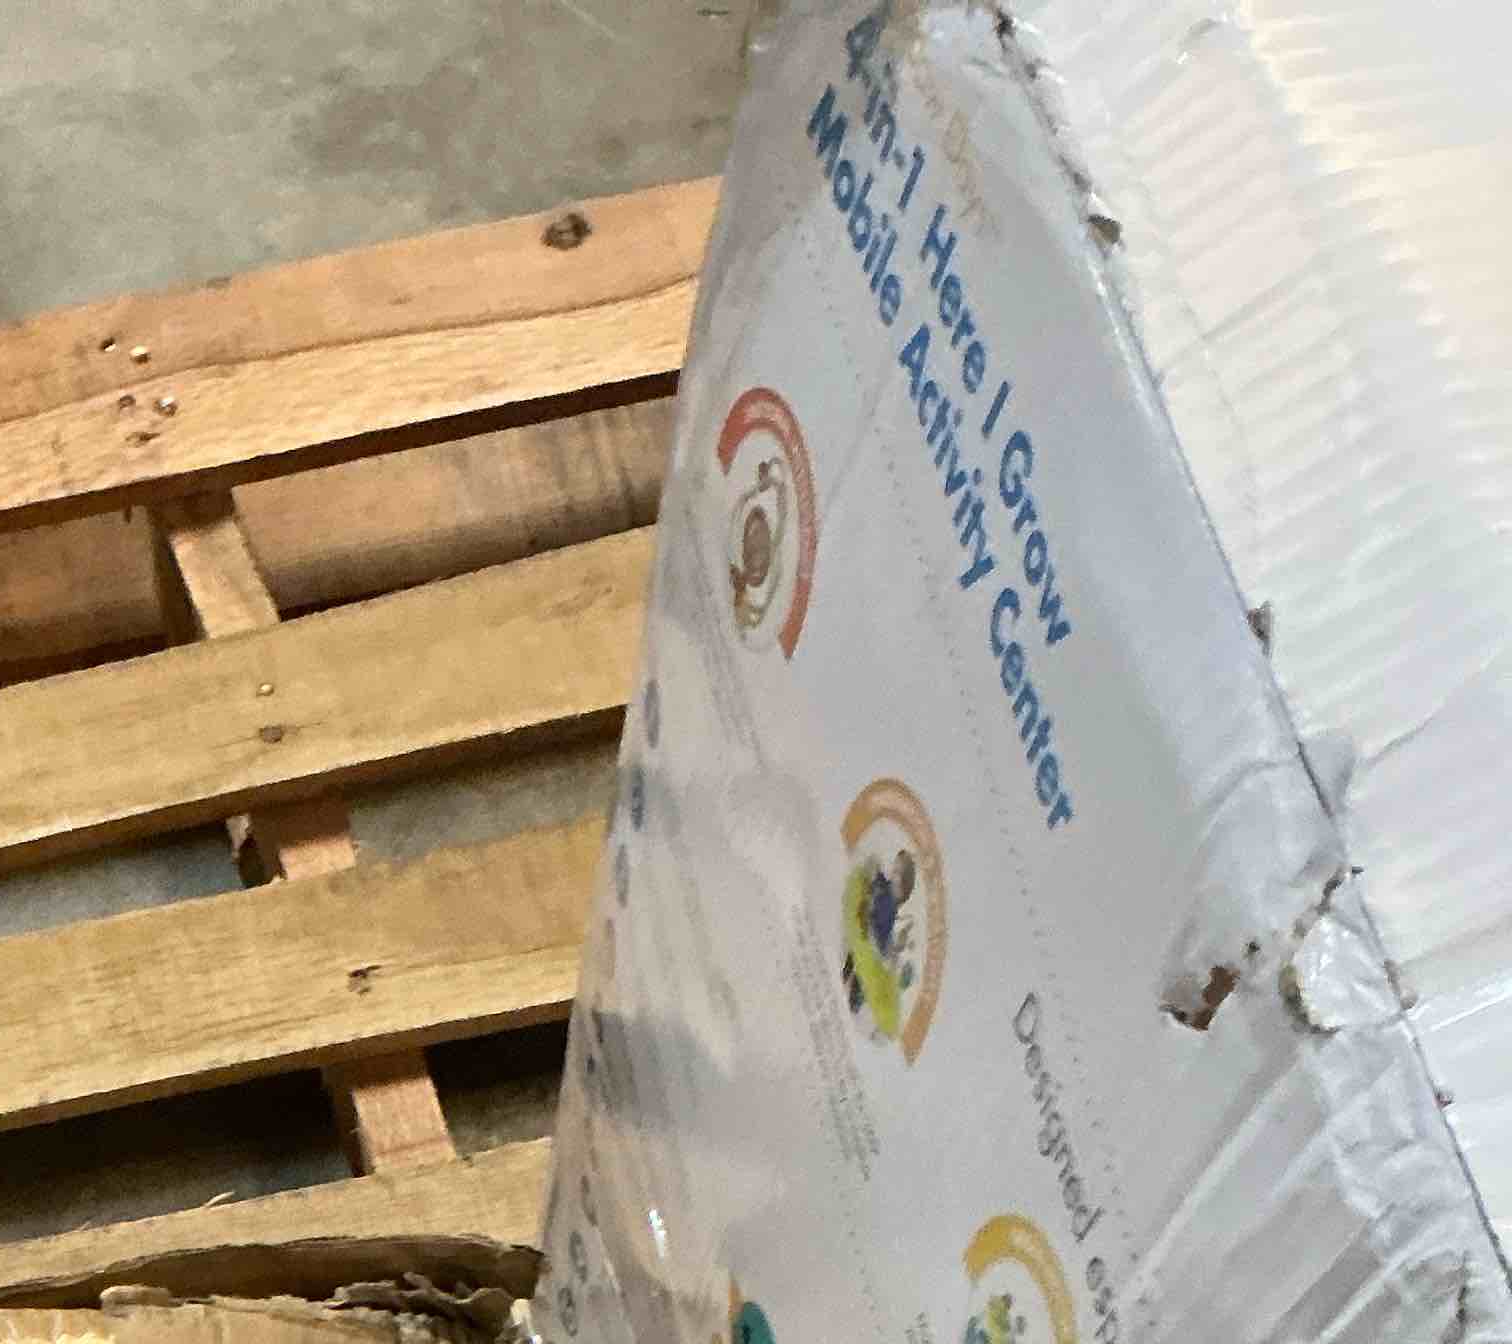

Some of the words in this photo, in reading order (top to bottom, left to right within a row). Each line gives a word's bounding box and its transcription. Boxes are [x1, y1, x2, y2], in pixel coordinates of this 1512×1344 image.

[807, 83, 902, 326] Mobile
[899, 323, 998, 589] Activity
[991, 587, 1075, 830] Center
[920, 204, 986, 394] Here
[982, 379, 1014, 439] I
[999, 430, 1073, 647] Grow
[1012, 991, 1107, 1242] Designed
